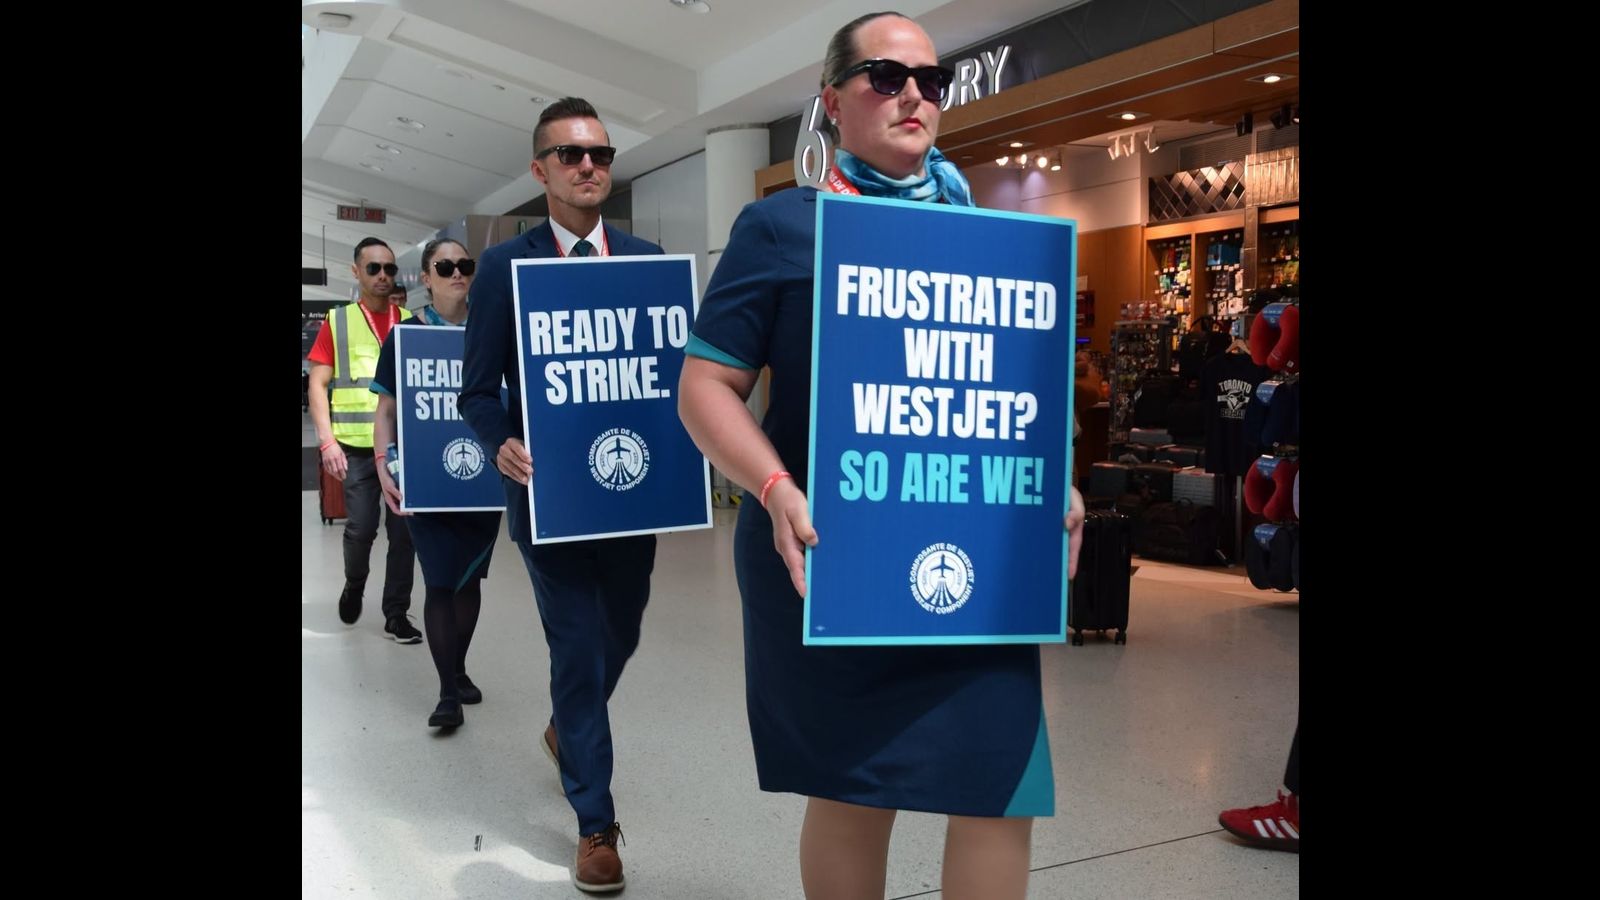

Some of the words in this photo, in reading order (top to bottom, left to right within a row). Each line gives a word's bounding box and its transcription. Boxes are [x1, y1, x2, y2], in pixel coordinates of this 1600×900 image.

[837, 264, 1057, 331] FRUSTRATED
[528, 306, 638, 356] READY
[647, 305, 689, 349] TO
[406, 358, 464, 388] READ
[903, 327, 994, 383] WITH
[544, 356, 671, 405] STRIKE.
[1218, 379, 1252, 394] TORONTO
[415, 391, 464, 421] STR
[852, 382, 1038, 441] WESTJET?
[588, 428, 619, 466] COMPOSANTE
[620, 428, 631, 436] DE
[631, 431, 650, 462] WESTJET
[590, 465, 616, 491] WESTJET
[616, 462, 650, 491] COMPONENT
[839, 449, 889, 502] SO
[900, 452, 970, 504] ARE
[981, 455, 1045, 506] WE!
[909, 543, 945, 584] COMPOSANTE
[946, 543, 958, 553] DE
[957, 548, 975, 583] WESTJET
[935, 584, 974, 615] COMPONENT
